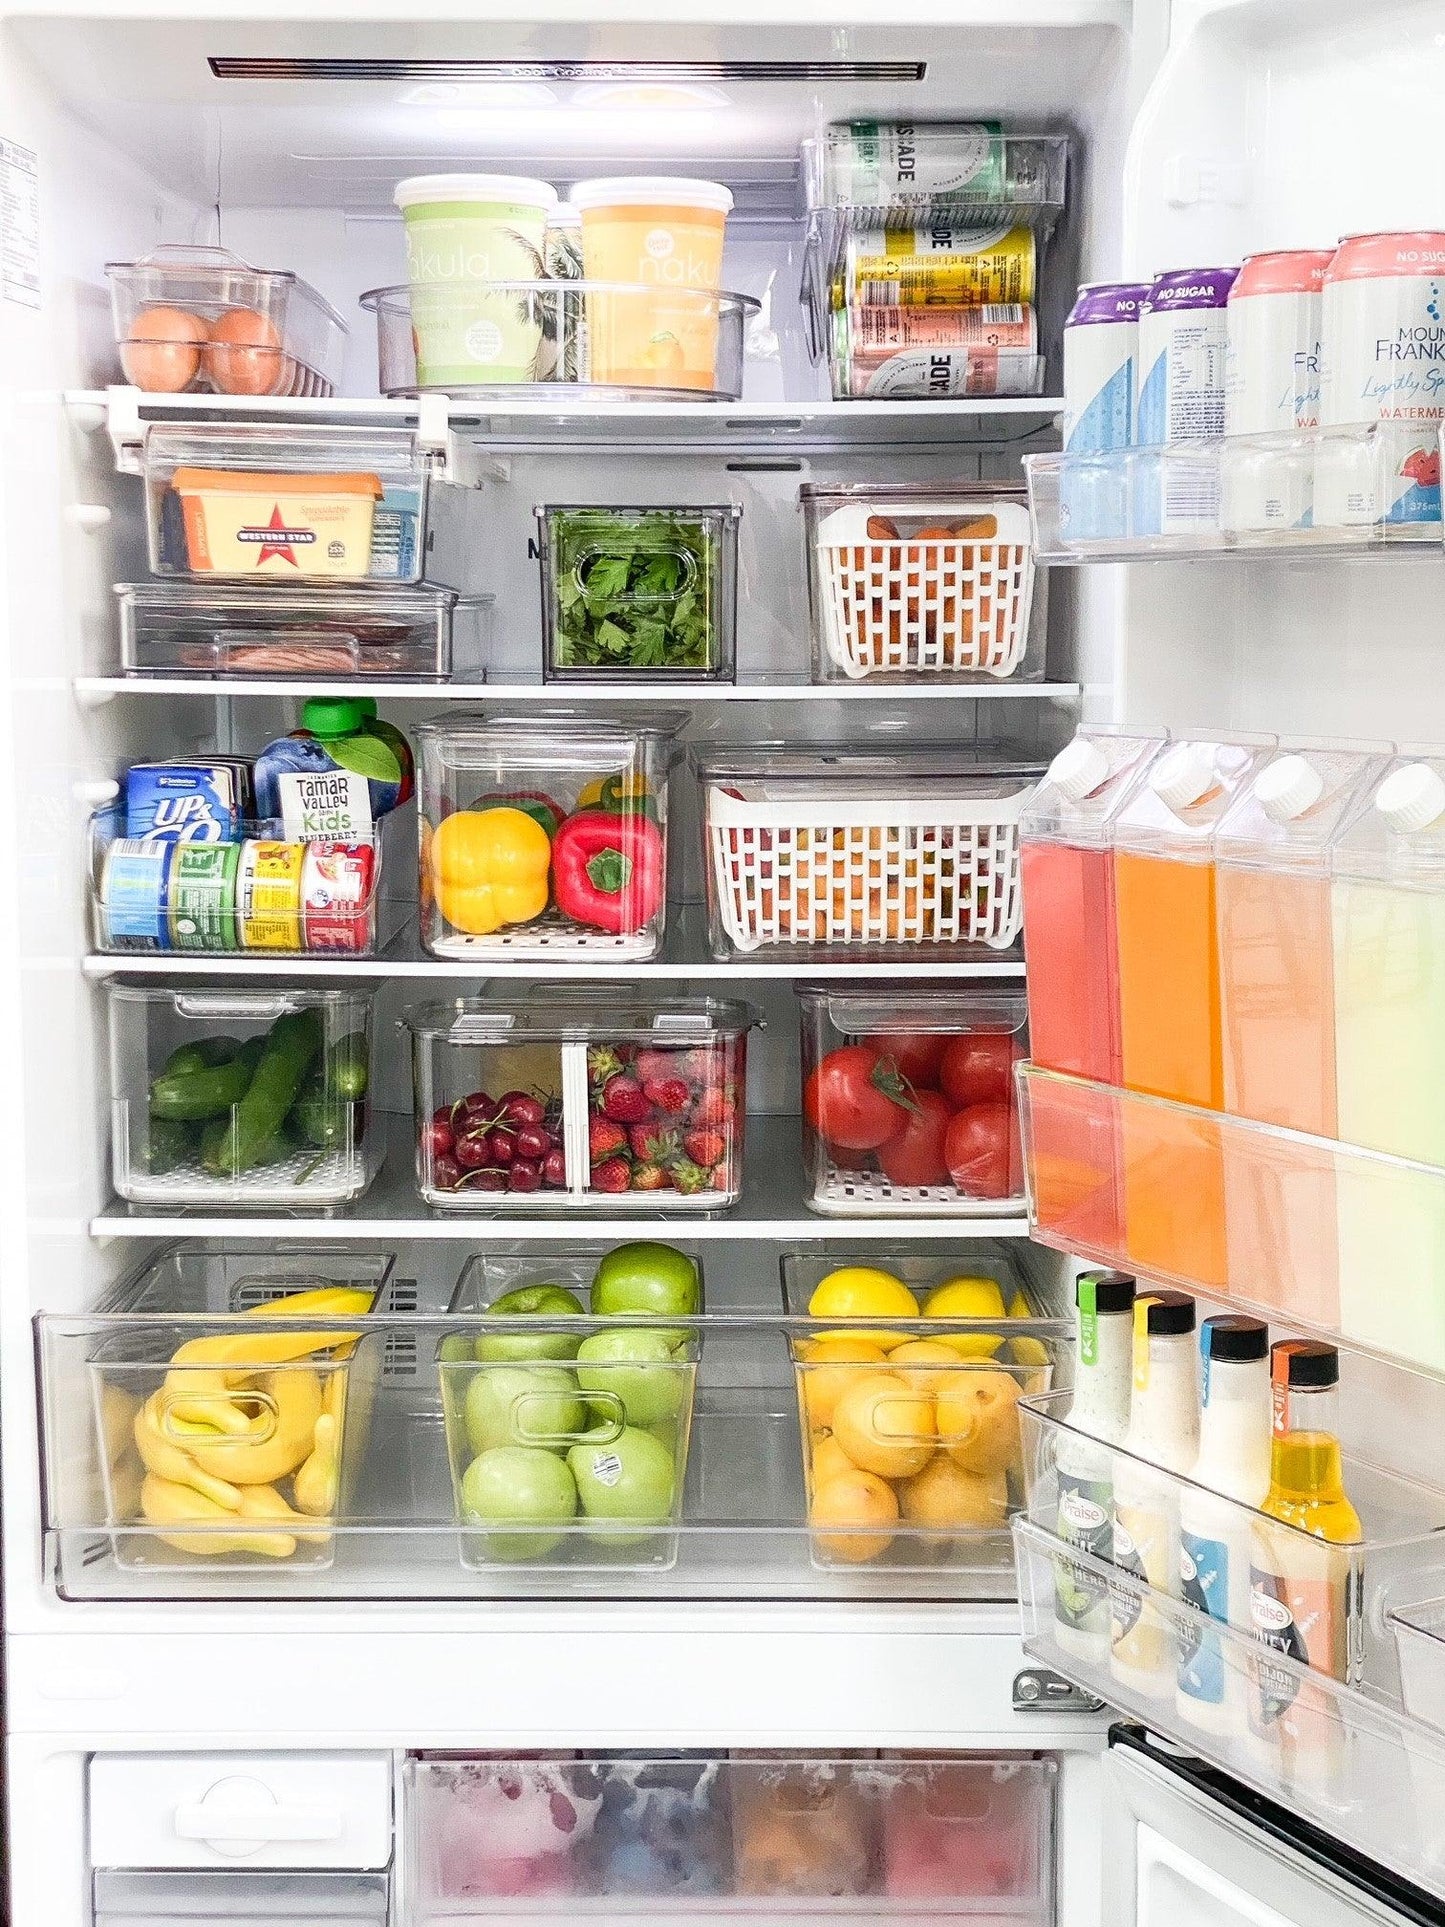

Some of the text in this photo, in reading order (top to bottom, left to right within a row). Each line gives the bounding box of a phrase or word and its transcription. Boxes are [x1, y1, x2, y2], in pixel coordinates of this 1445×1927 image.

[1396, 250, 1418, 262] NO
[1156, 285, 1215, 300] NO SUGAR
[1116, 300, 1136, 311] NO
[239, 531, 313, 542] WESTERN STAR
[302, 811, 352, 833] Kids
[298, 830, 358, 843] BLUEBERRY
